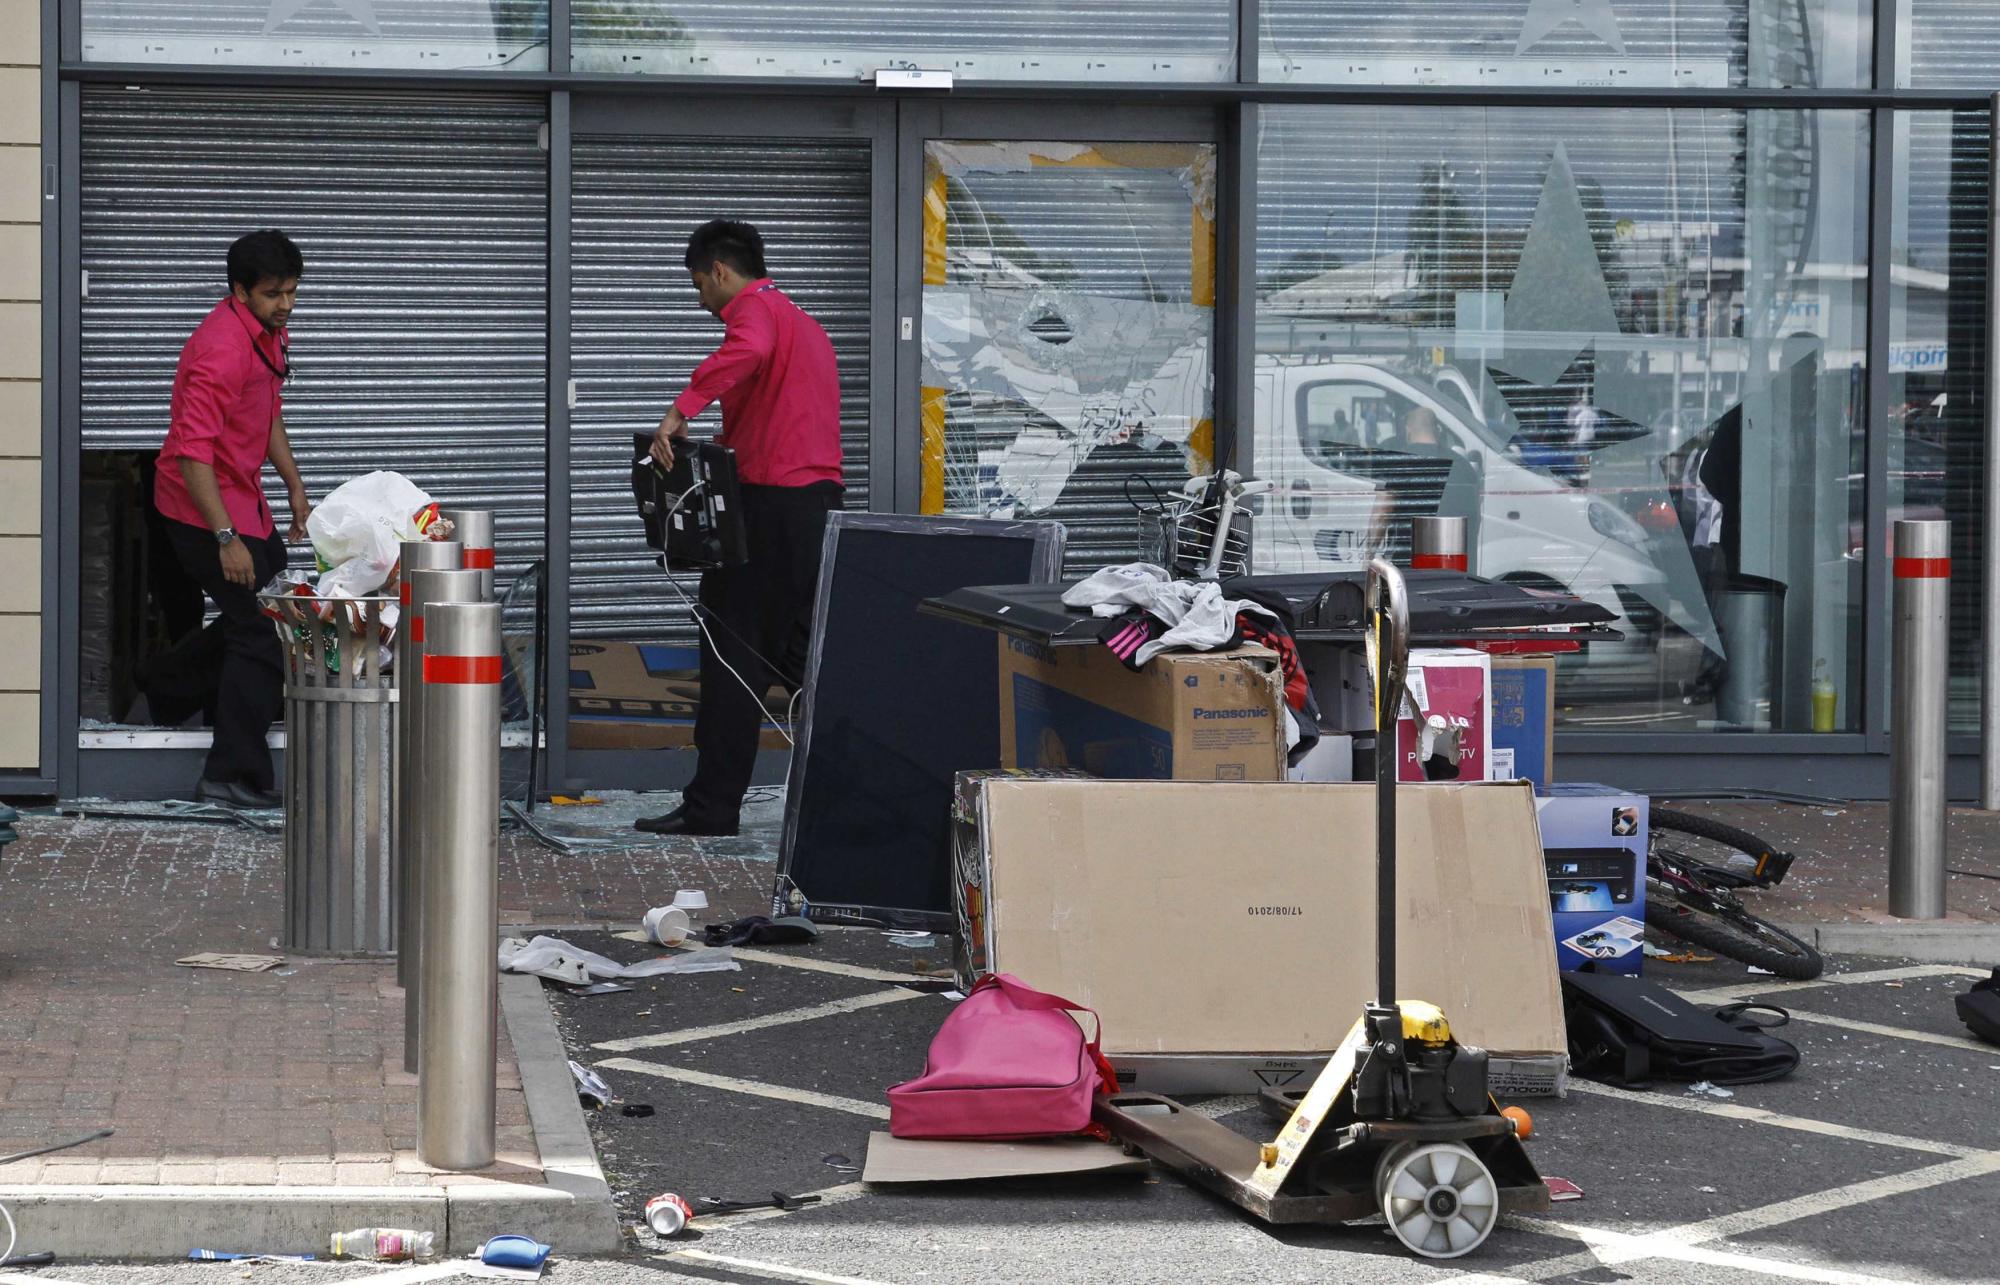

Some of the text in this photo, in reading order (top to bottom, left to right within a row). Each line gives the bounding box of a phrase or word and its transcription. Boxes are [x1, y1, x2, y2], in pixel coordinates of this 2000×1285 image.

[1193, 706, 1269, 720] Panasonic
[1450, 716, 1469, 727] LG
[1459, 748, 1475, 760] TV
[1248, 906, 1303, 916] 17/08/2010
